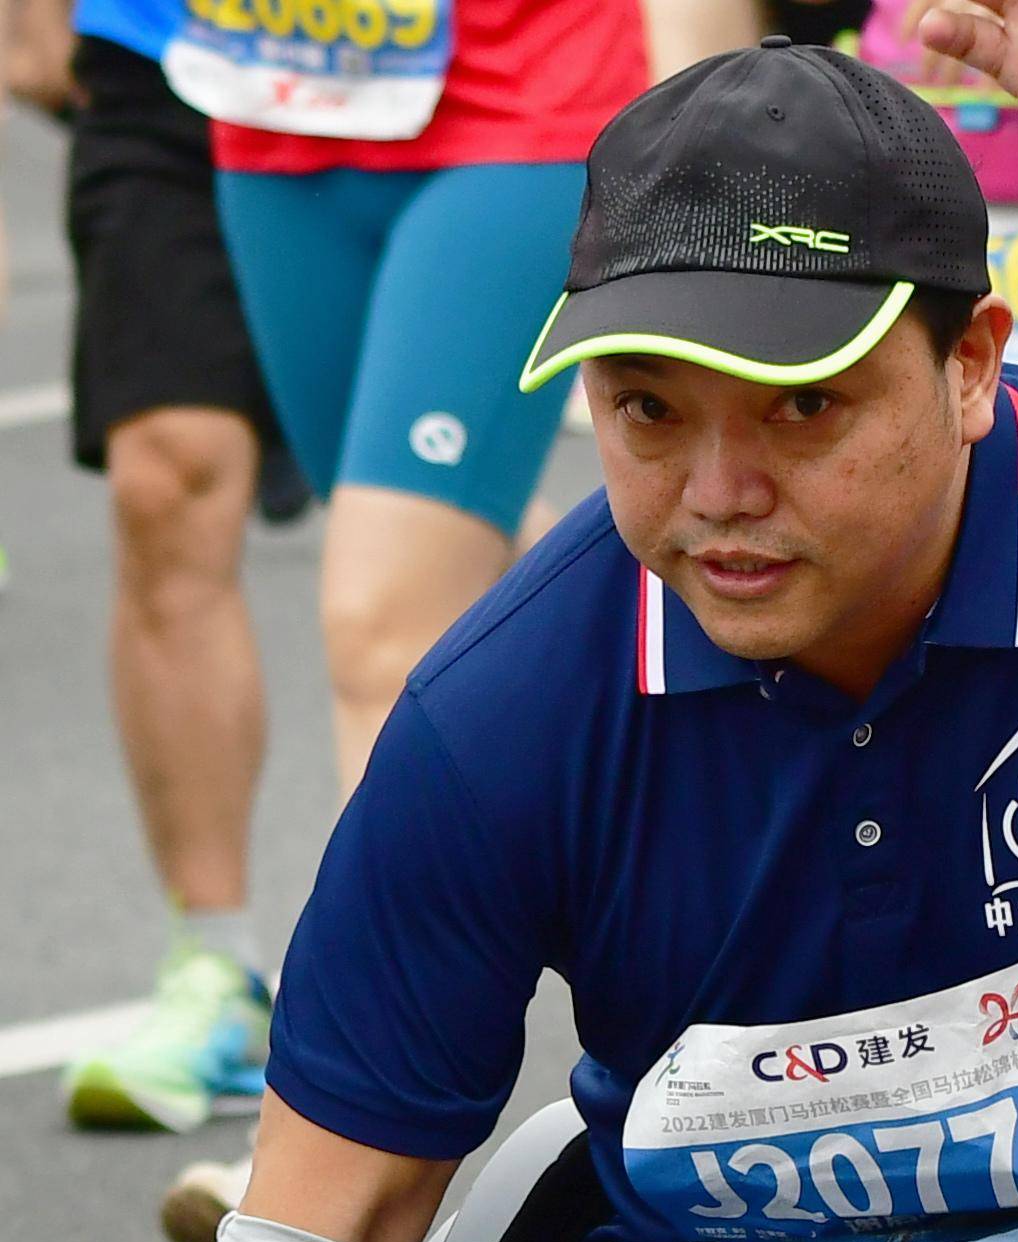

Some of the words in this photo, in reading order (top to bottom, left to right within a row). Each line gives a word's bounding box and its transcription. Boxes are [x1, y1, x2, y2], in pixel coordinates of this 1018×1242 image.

[750, 223, 850, 253] XRC
[751, 1042, 849, 1083] C&D
[856, 1023, 935, 1069] 建发
